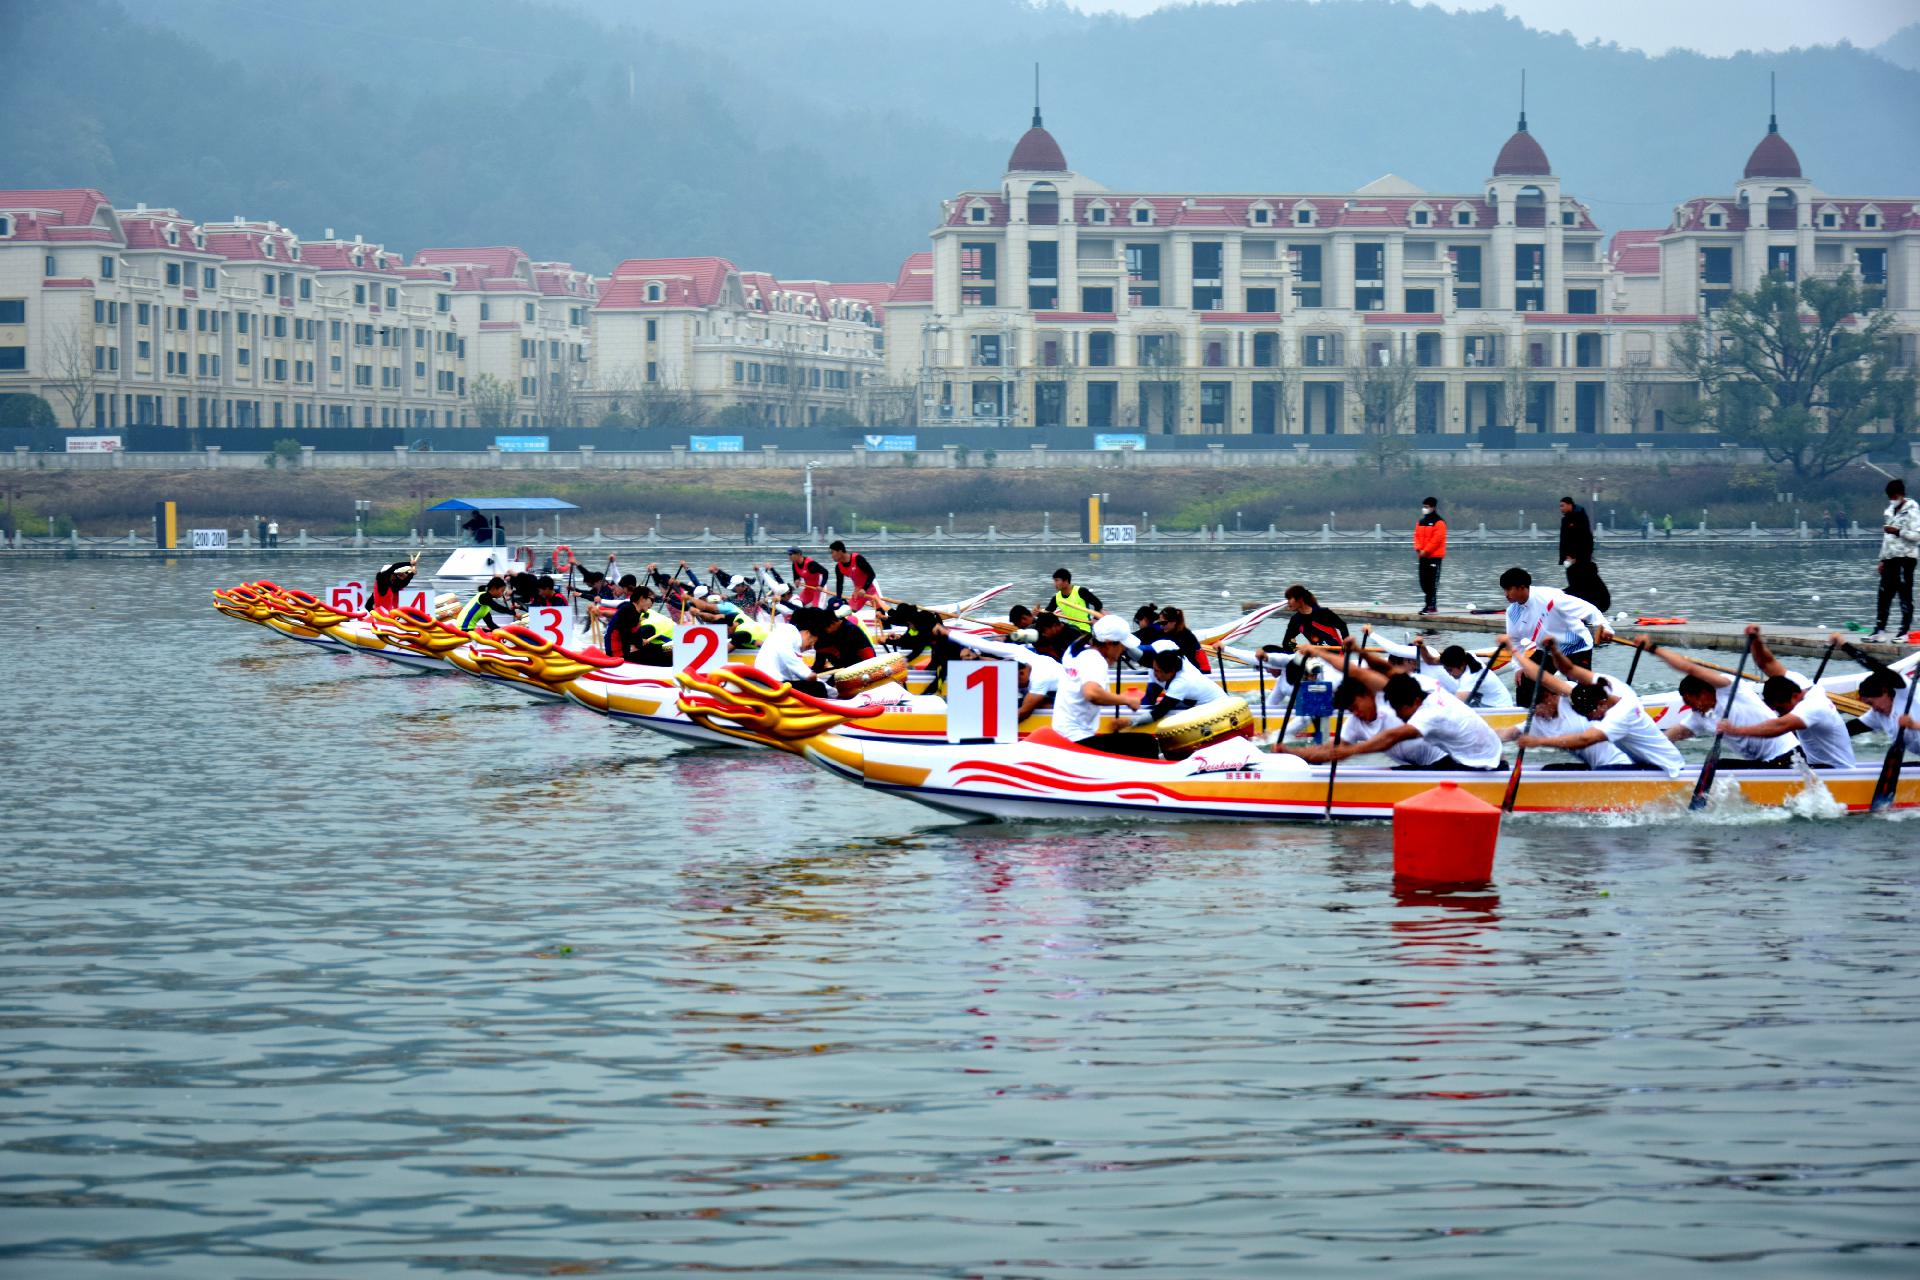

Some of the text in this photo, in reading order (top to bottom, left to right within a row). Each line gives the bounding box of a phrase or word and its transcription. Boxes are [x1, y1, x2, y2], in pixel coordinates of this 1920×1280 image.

[333, 588, 353, 612] 5
[410, 592, 430, 617] 4
[540, 608, 563, 647] 3
[682, 627, 719, 678] 2
[966, 665, 998, 737] 1
